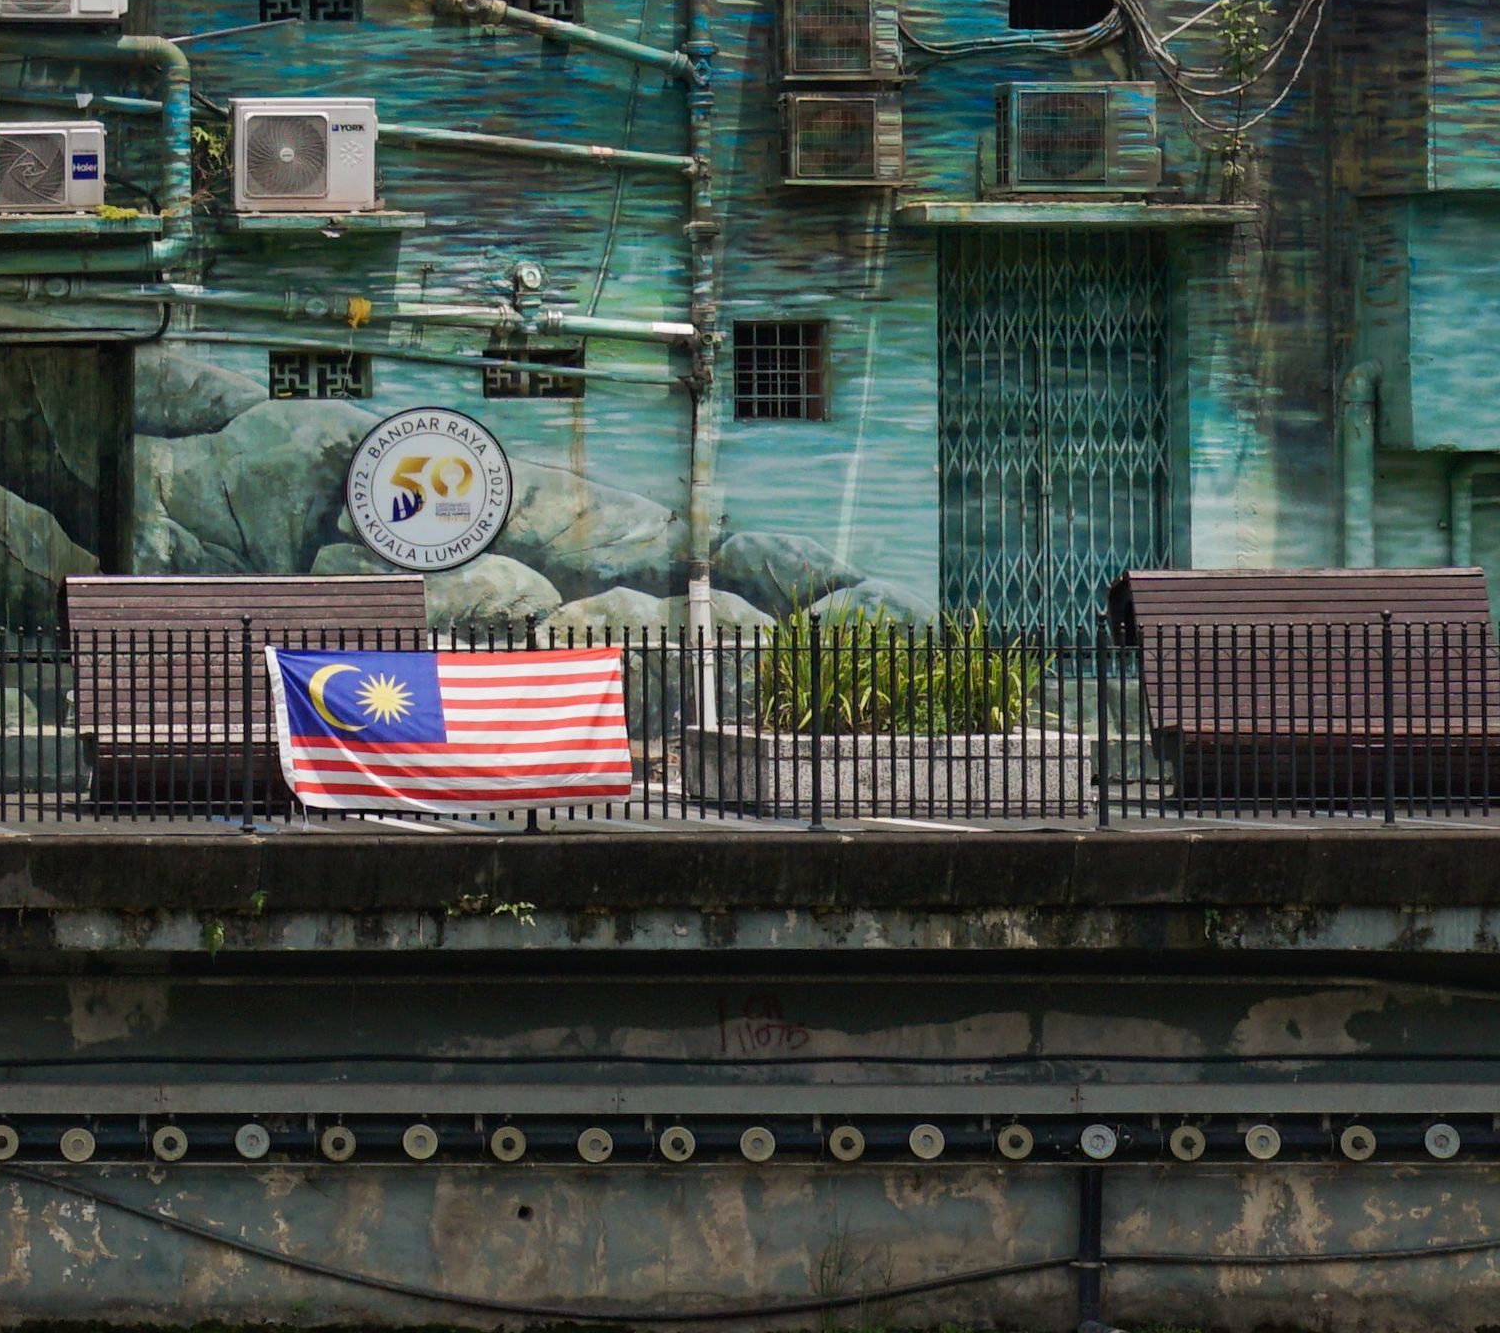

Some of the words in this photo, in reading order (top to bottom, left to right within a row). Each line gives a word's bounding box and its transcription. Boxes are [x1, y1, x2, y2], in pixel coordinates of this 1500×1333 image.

[340, 124, 365, 132] YORK
[72, 162, 98, 172] Haier
[354, 470, 369, 510] 1972
[368, 417, 440, 459] BANDAR
[447, 421, 487, 456] RAYA
[488, 465, 504, 507] 2022
[390, 456, 474, 514] 50
[365, 519, 417, 562] KUALA
[425, 518, 493, 563] LUMPUR
